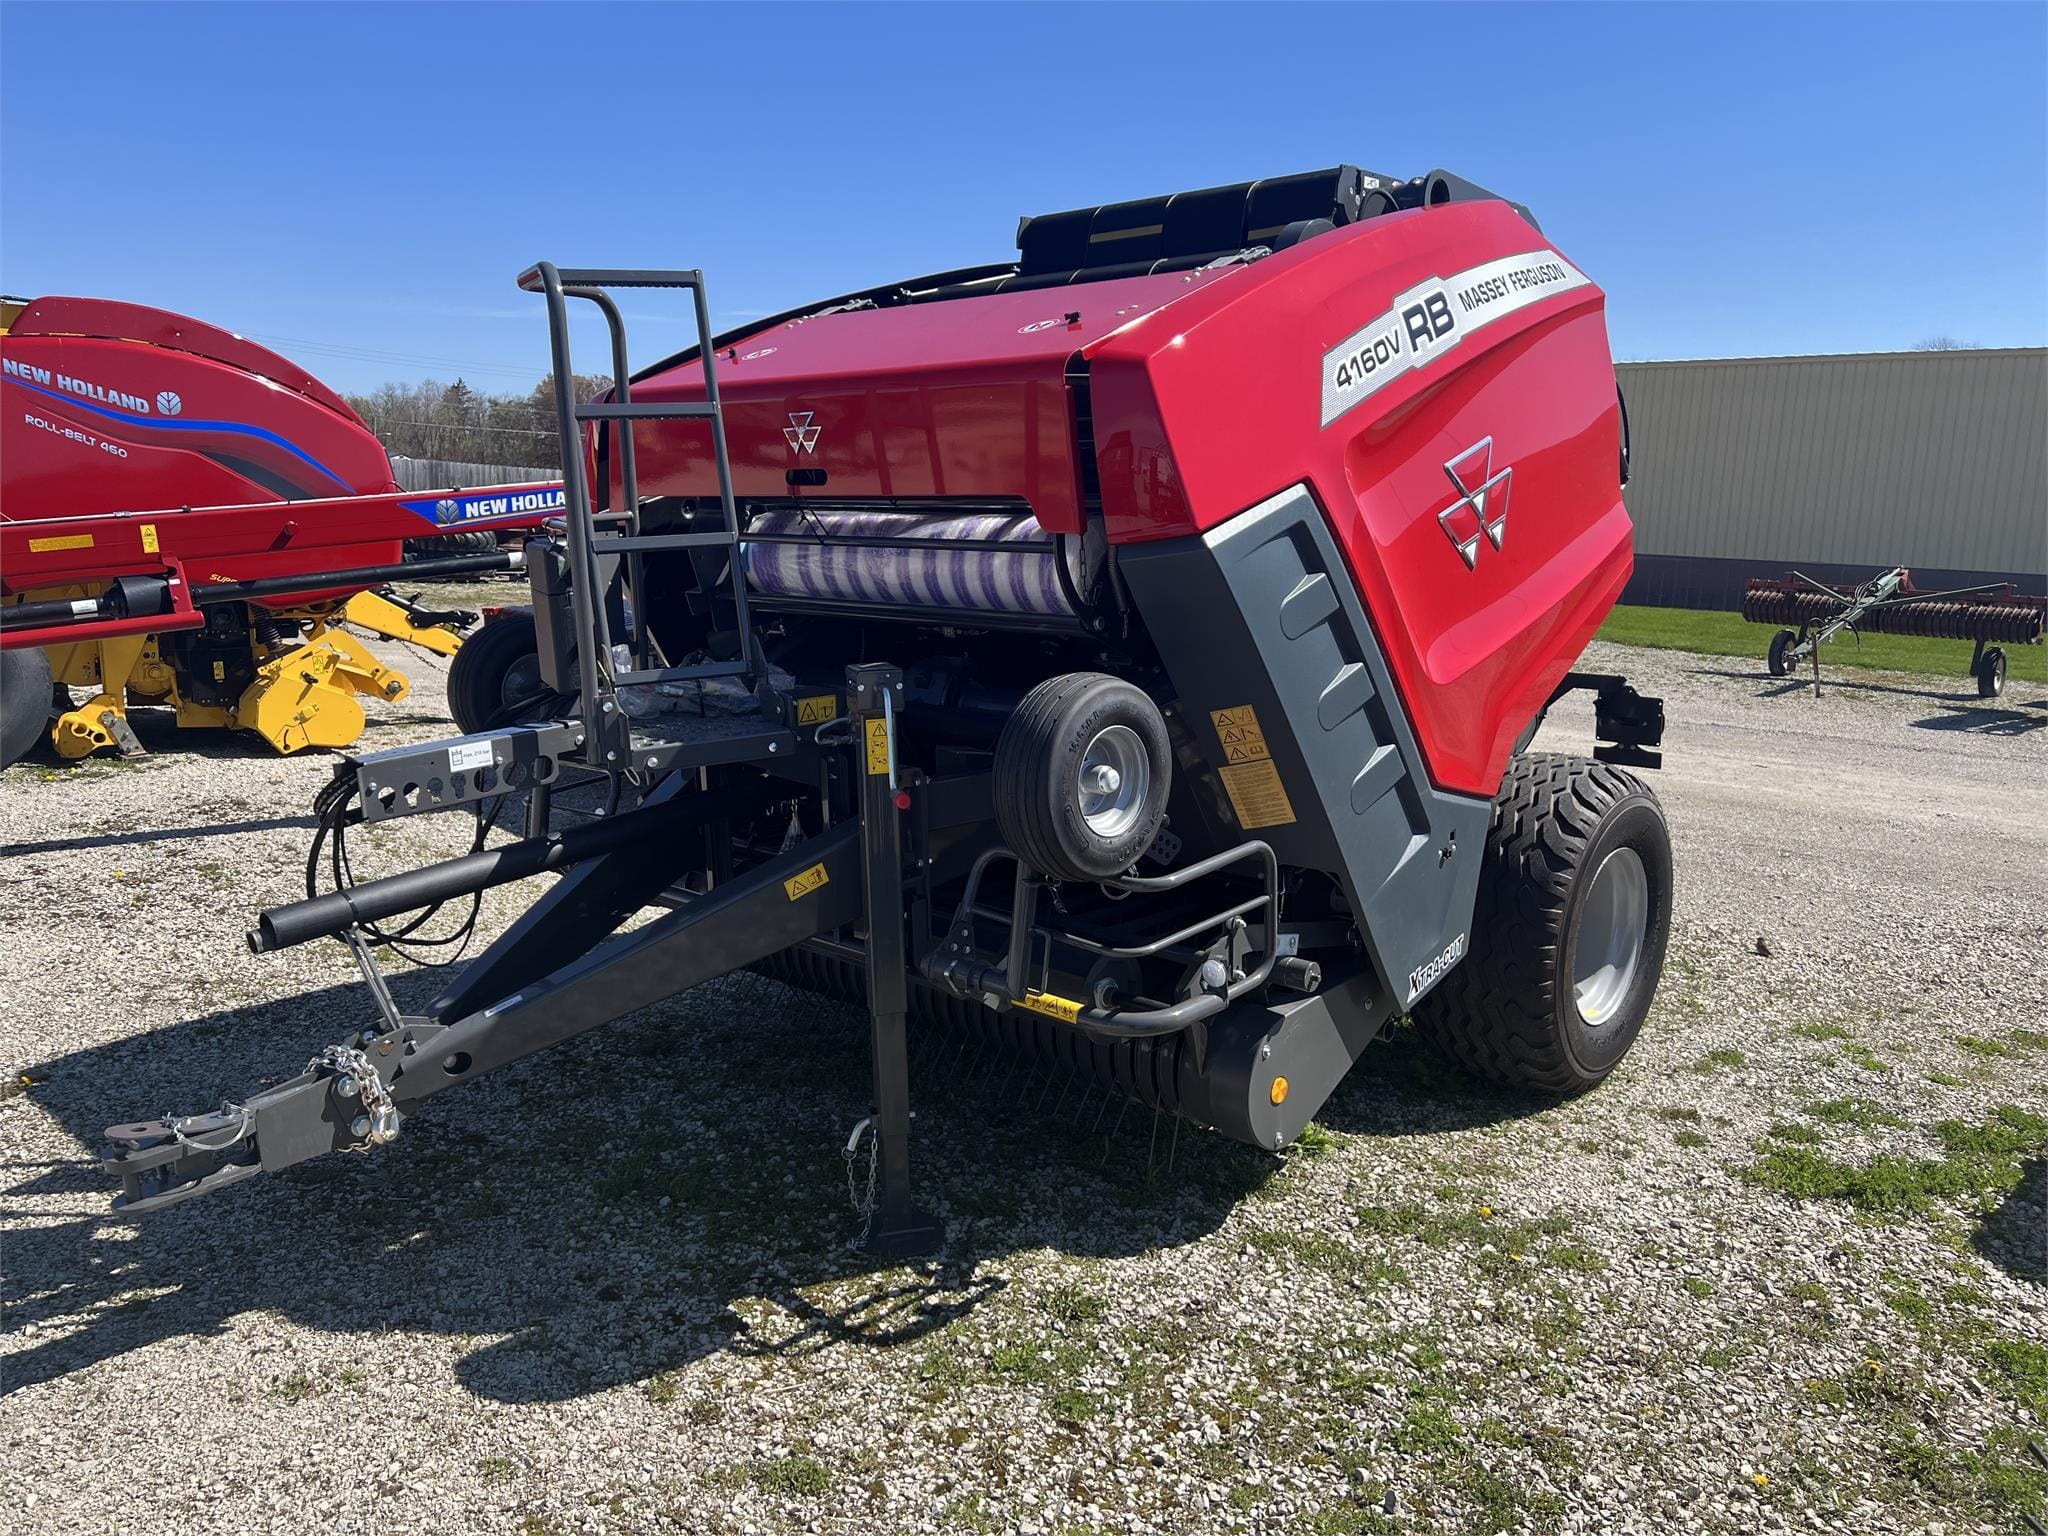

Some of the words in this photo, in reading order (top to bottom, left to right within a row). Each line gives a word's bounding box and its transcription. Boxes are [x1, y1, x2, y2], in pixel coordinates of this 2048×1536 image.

[1336, 329, 1400, 388] 4160V
[1402, 291, 1455, 353] RB
[1458, 275, 1510, 312] MASSEY
[1508, 263, 1567, 293] FERGUSON
[2, 358, 51, 385] NEW
[56, 374, 150, 413] HOLLAND
[25, 414, 96, 447] ROLL-BELT
[100, 442, 128, 458] 460
[465, 498, 507, 518] NEW
[511, 491, 566, 512] HOLLA
[1407, 933, 1464, 1003] XTRA-CUT
